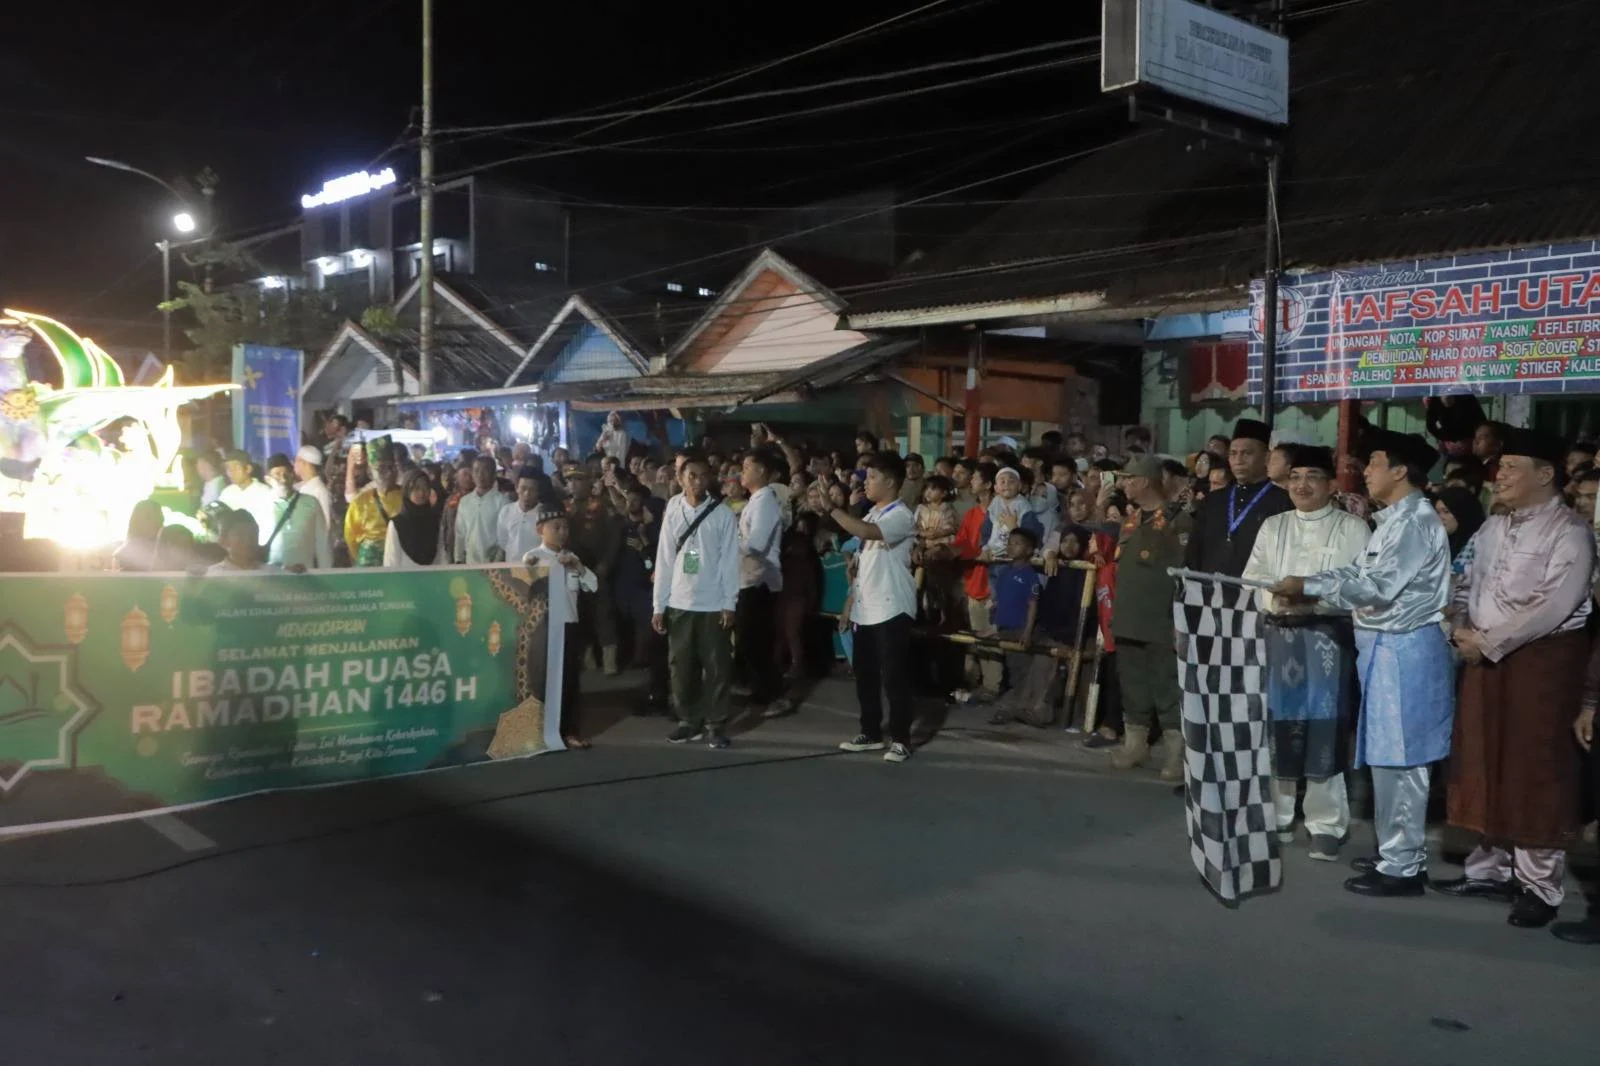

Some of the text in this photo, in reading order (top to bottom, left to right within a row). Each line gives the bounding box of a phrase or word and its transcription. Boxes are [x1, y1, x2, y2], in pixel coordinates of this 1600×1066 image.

[1331, 272, 1600, 327] HAFSAH UTA
[1332, 335, 1382, 349] UNDANGAN
[1389, 333, 1416, 345] NOTA
[1424, 330, 1446, 343] KOP
[1448, 328, 1482, 341] SURAT
[1490, 325, 1529, 339] YAASIN
[1367, 350, 1423, 364] PENJILIDAN
[1431, 348, 1459, 361] HARD
[1462, 345, 1497, 359] COVER
[1507, 342, 1535, 356] SOFT
[1538, 340, 1577, 354] COVER
[1306, 371, 1345, 385] SPANDUK
[1352, 368, 1391, 382] BALEHO
[1399, 368, 1406, 380] X
[1415, 366, 1457, 380] BANNER
[1465, 364, 1486, 377] ONE
[1488, 363, 1512, 376] WAY
[1521, 361, 1561, 374] STIKER
[276, 619, 368, 638] MENGUCAPKAN
[216, 637, 419, 662] SELAMAT MENJALANKAN
[172, 651, 452, 698] IBADAH PUASA
[131, 676, 477, 734] RAMADHAN 1446 H
